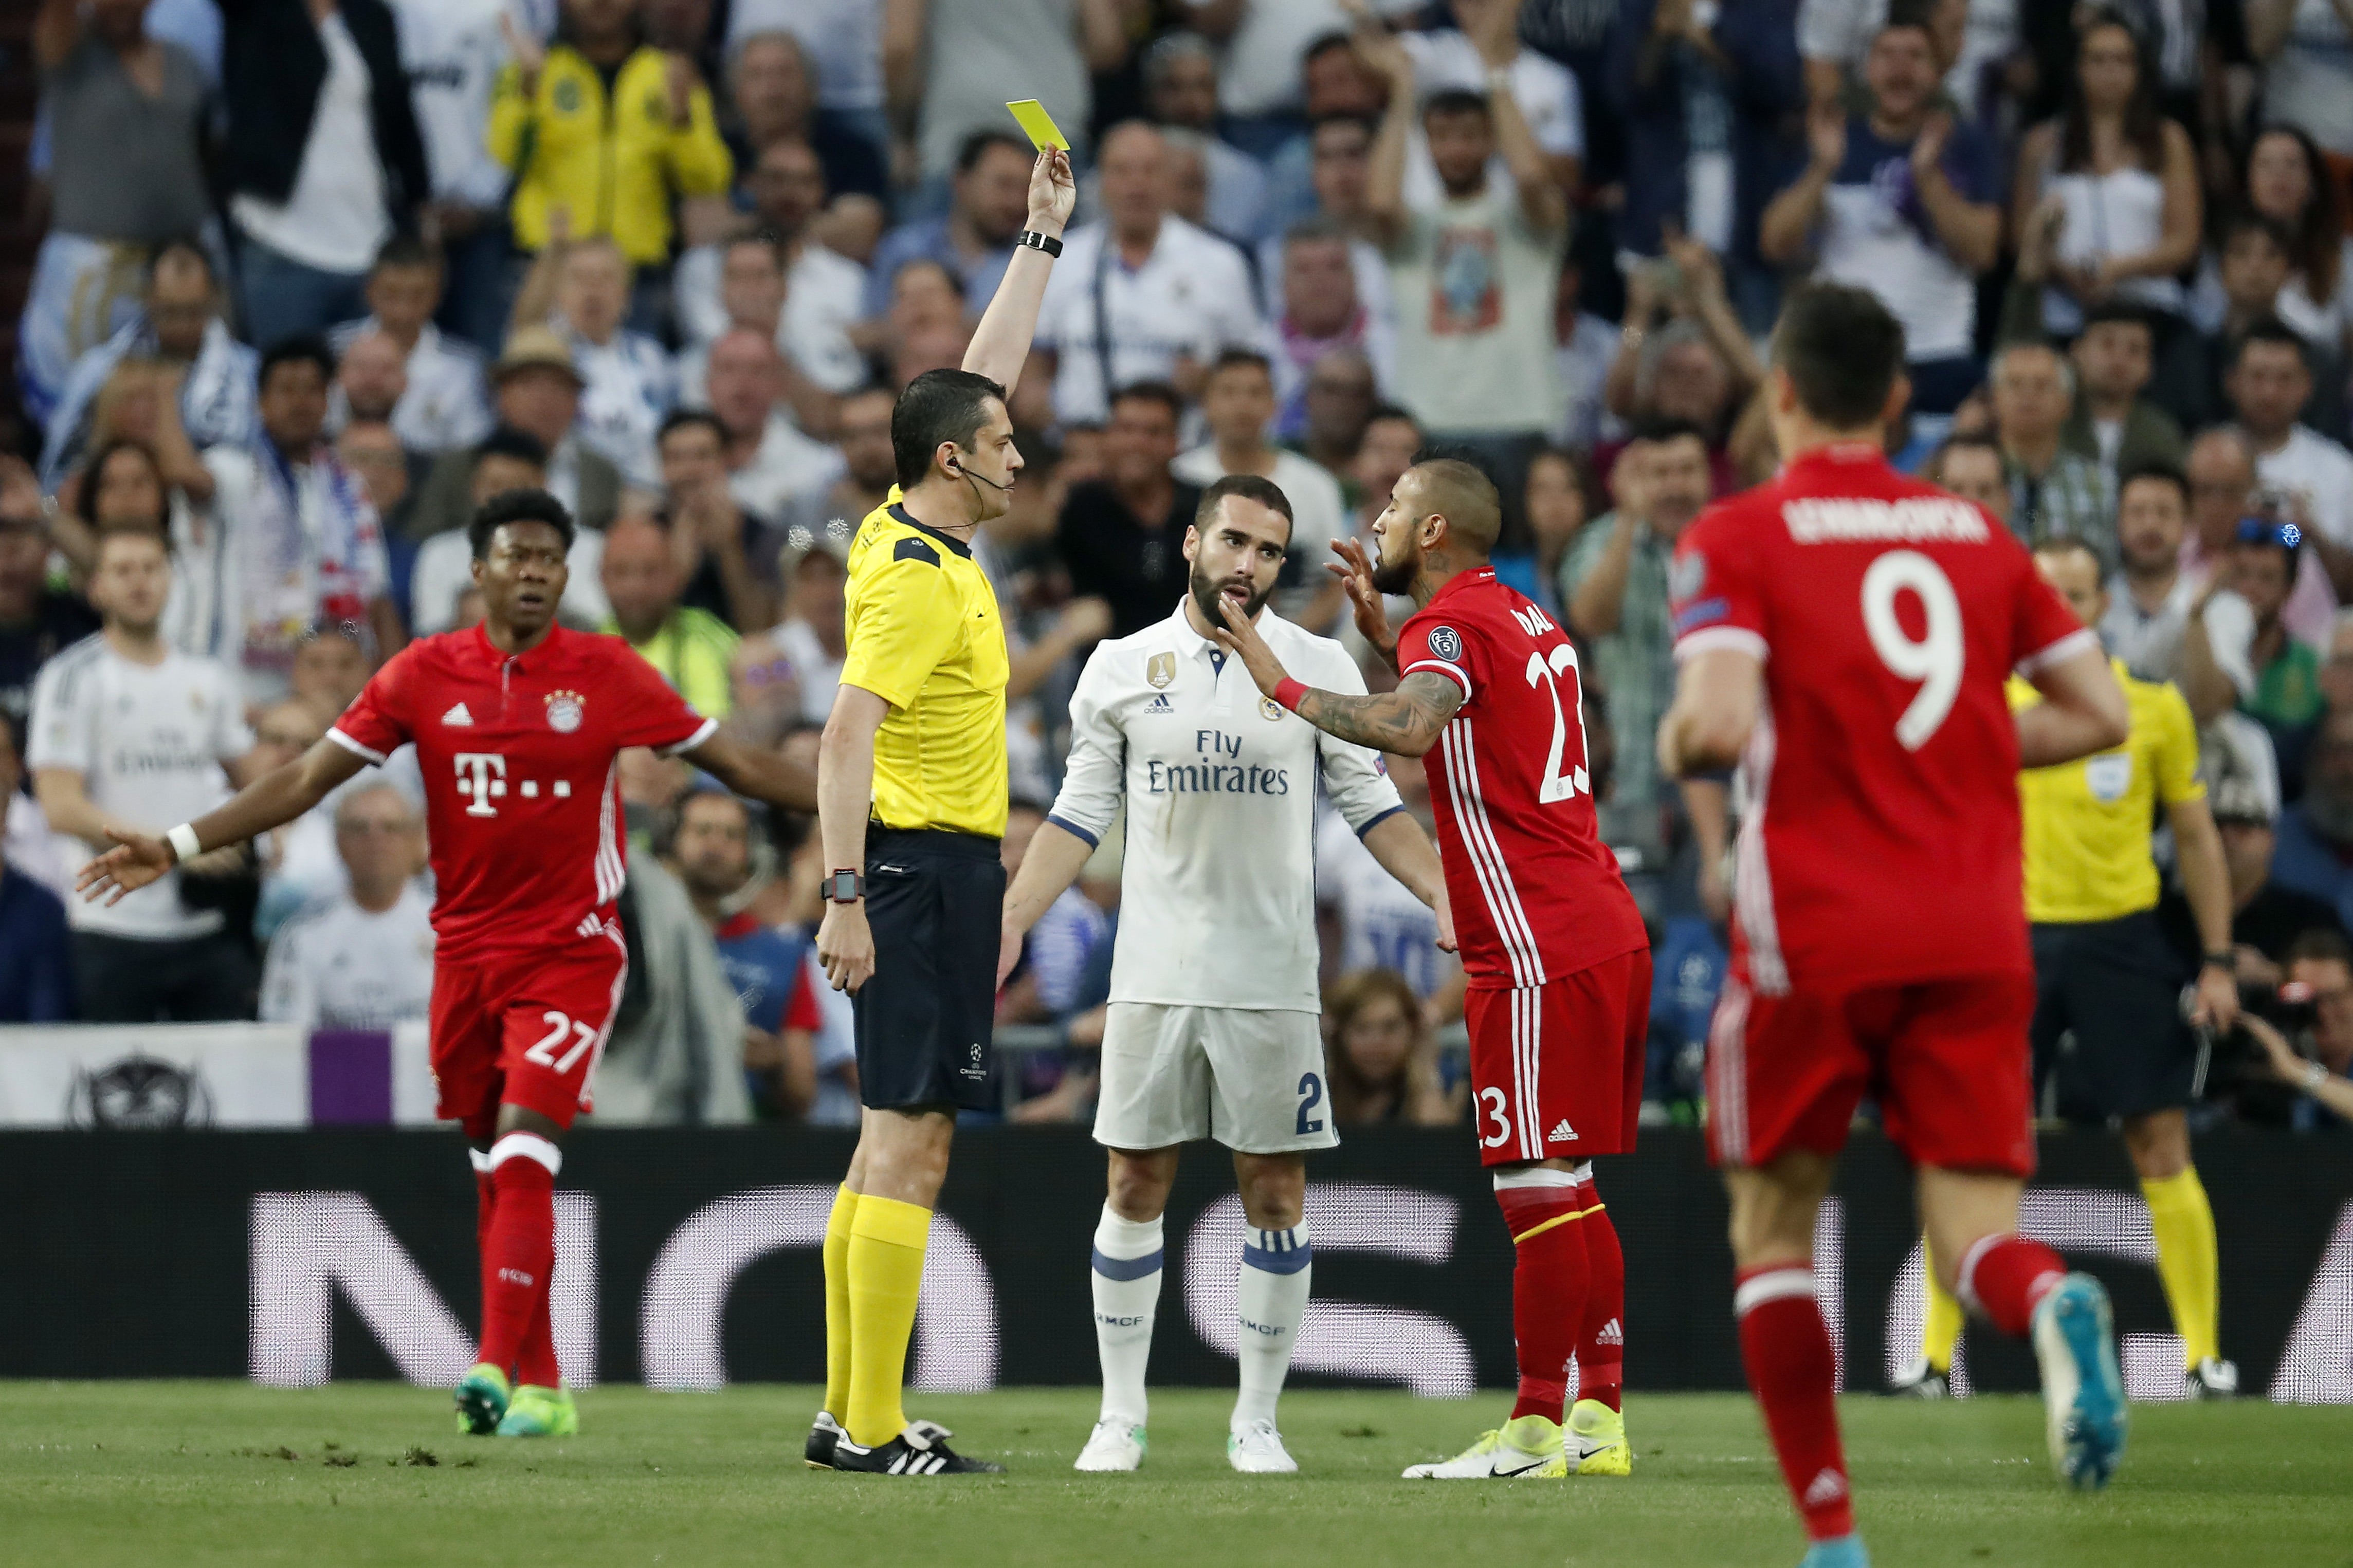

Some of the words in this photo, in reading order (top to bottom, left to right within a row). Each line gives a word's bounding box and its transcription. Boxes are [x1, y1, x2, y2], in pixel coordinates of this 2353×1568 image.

[1443, 642, 1451, 652] 5
[1860, 549, 1966, 753] 9
[1144, 706, 1174, 714] adidas
[1525, 643, 1590, 804] 23
[1197, 730, 1242, 759] Fly
[1148, 759, 1288, 796] Emirates
[525, 1010, 597, 1075] 27
[1296, 1072, 1323, 1136] 2
[1547, 1132, 1579, 1142] adidas
[1096, 1312, 1144, 1326] RMCF
